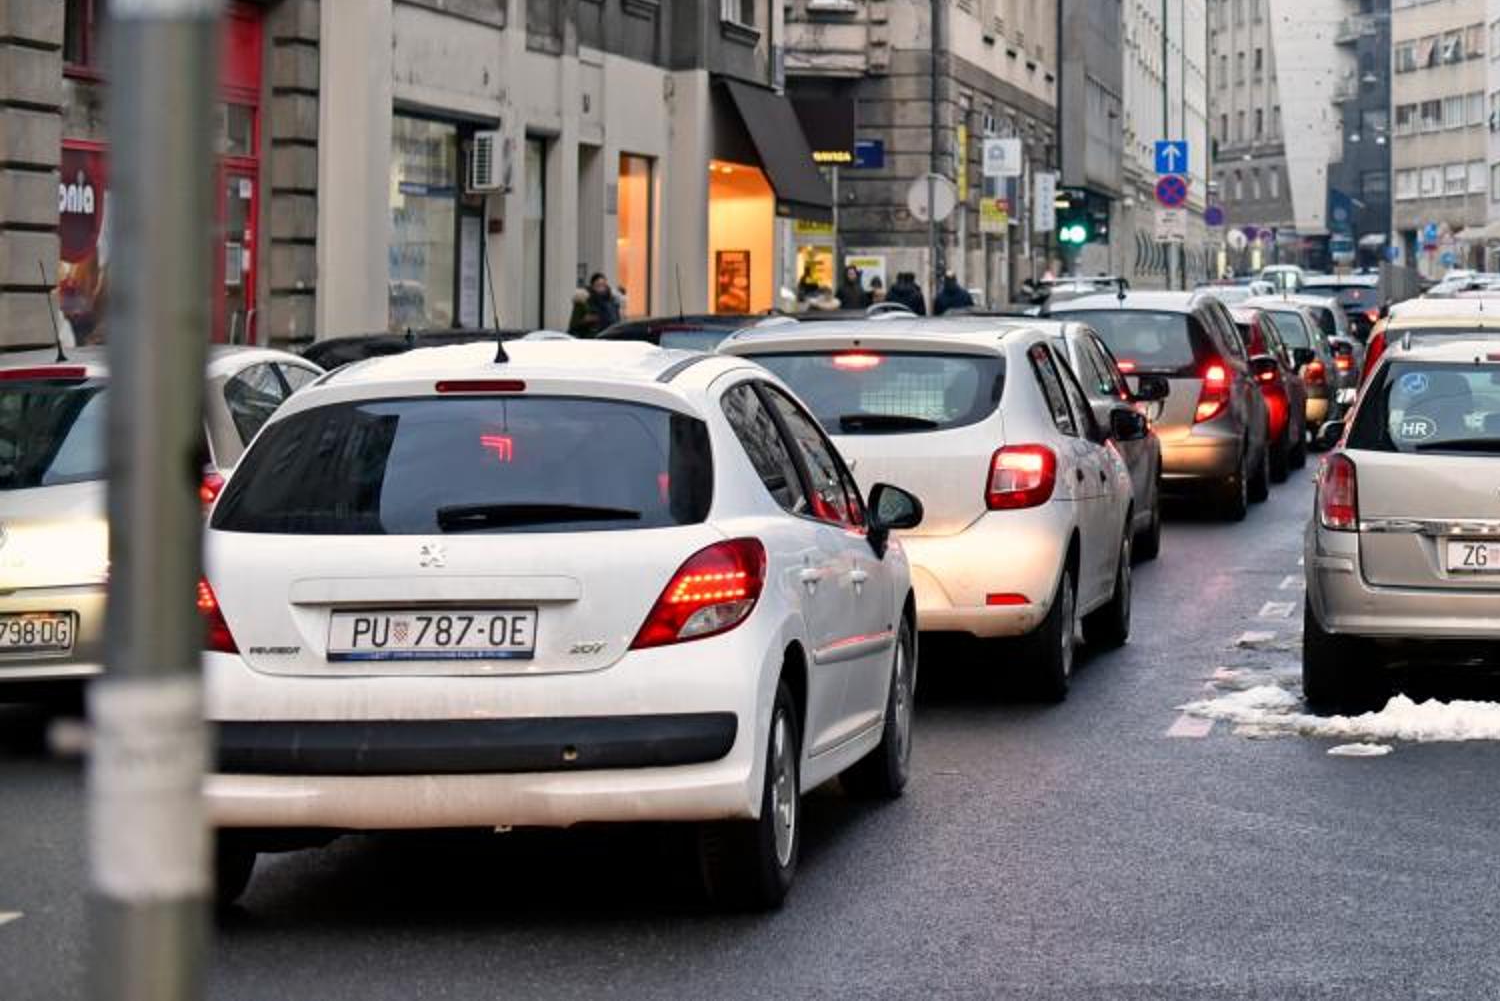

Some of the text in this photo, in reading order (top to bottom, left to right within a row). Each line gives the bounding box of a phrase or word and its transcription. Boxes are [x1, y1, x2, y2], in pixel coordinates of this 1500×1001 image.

[1401, 422, 1427, 435] HR
[1463, 545, 1487, 566] ZG
[352, 616, 527, 647] PU 787-OE
